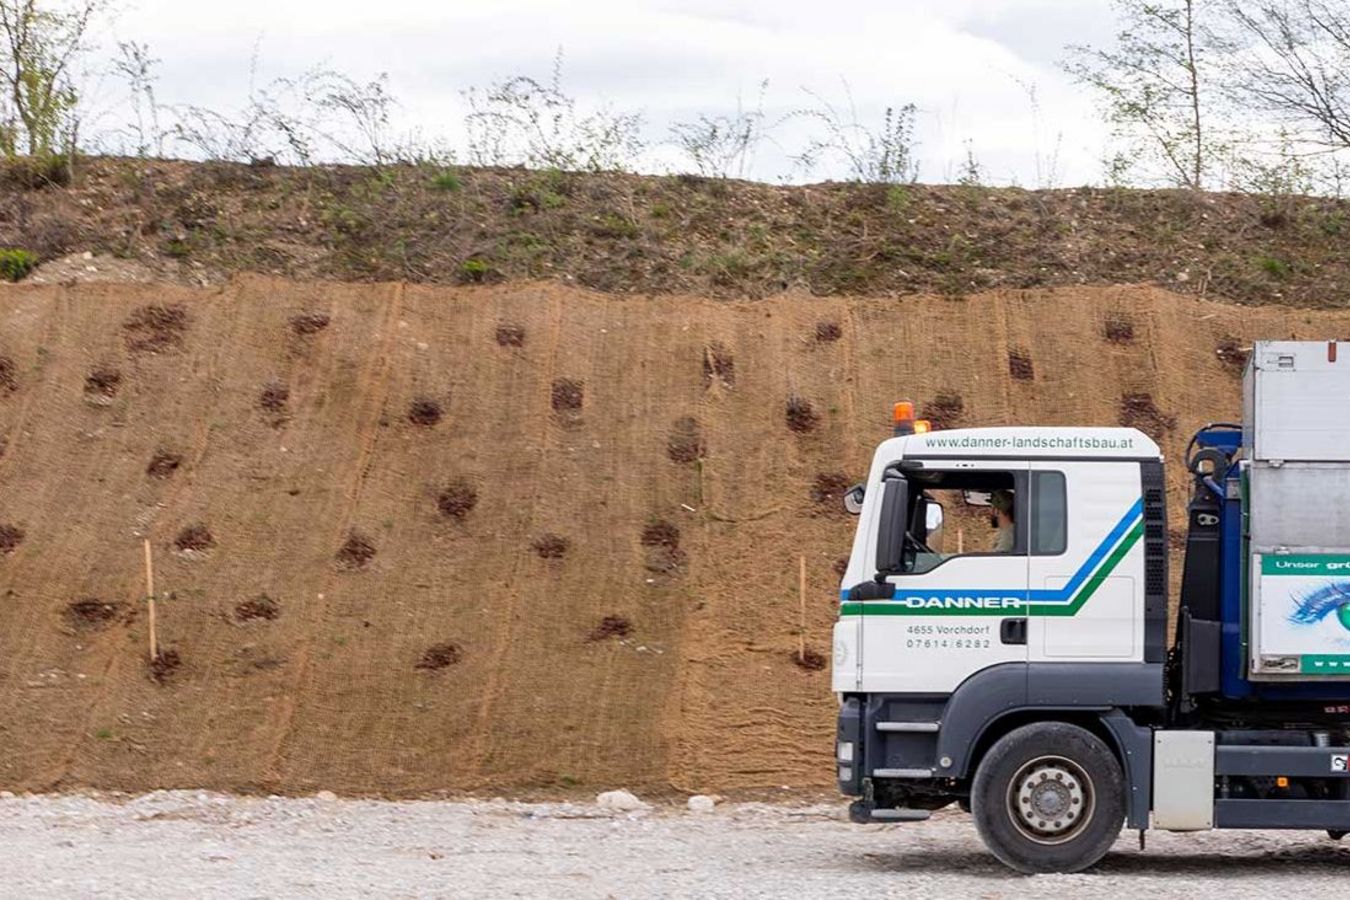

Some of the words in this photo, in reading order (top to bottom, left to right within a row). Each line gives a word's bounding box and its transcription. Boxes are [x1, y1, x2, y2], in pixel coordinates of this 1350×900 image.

[925, 436, 1133, 449] www.danner-landschaftsbau.at
[1275, 561, 1319, 569] Unser
[906, 597, 1020, 608] DANNER
[907, 626, 933, 634] 4655
[936, 625, 990, 634] Vorchdorf
